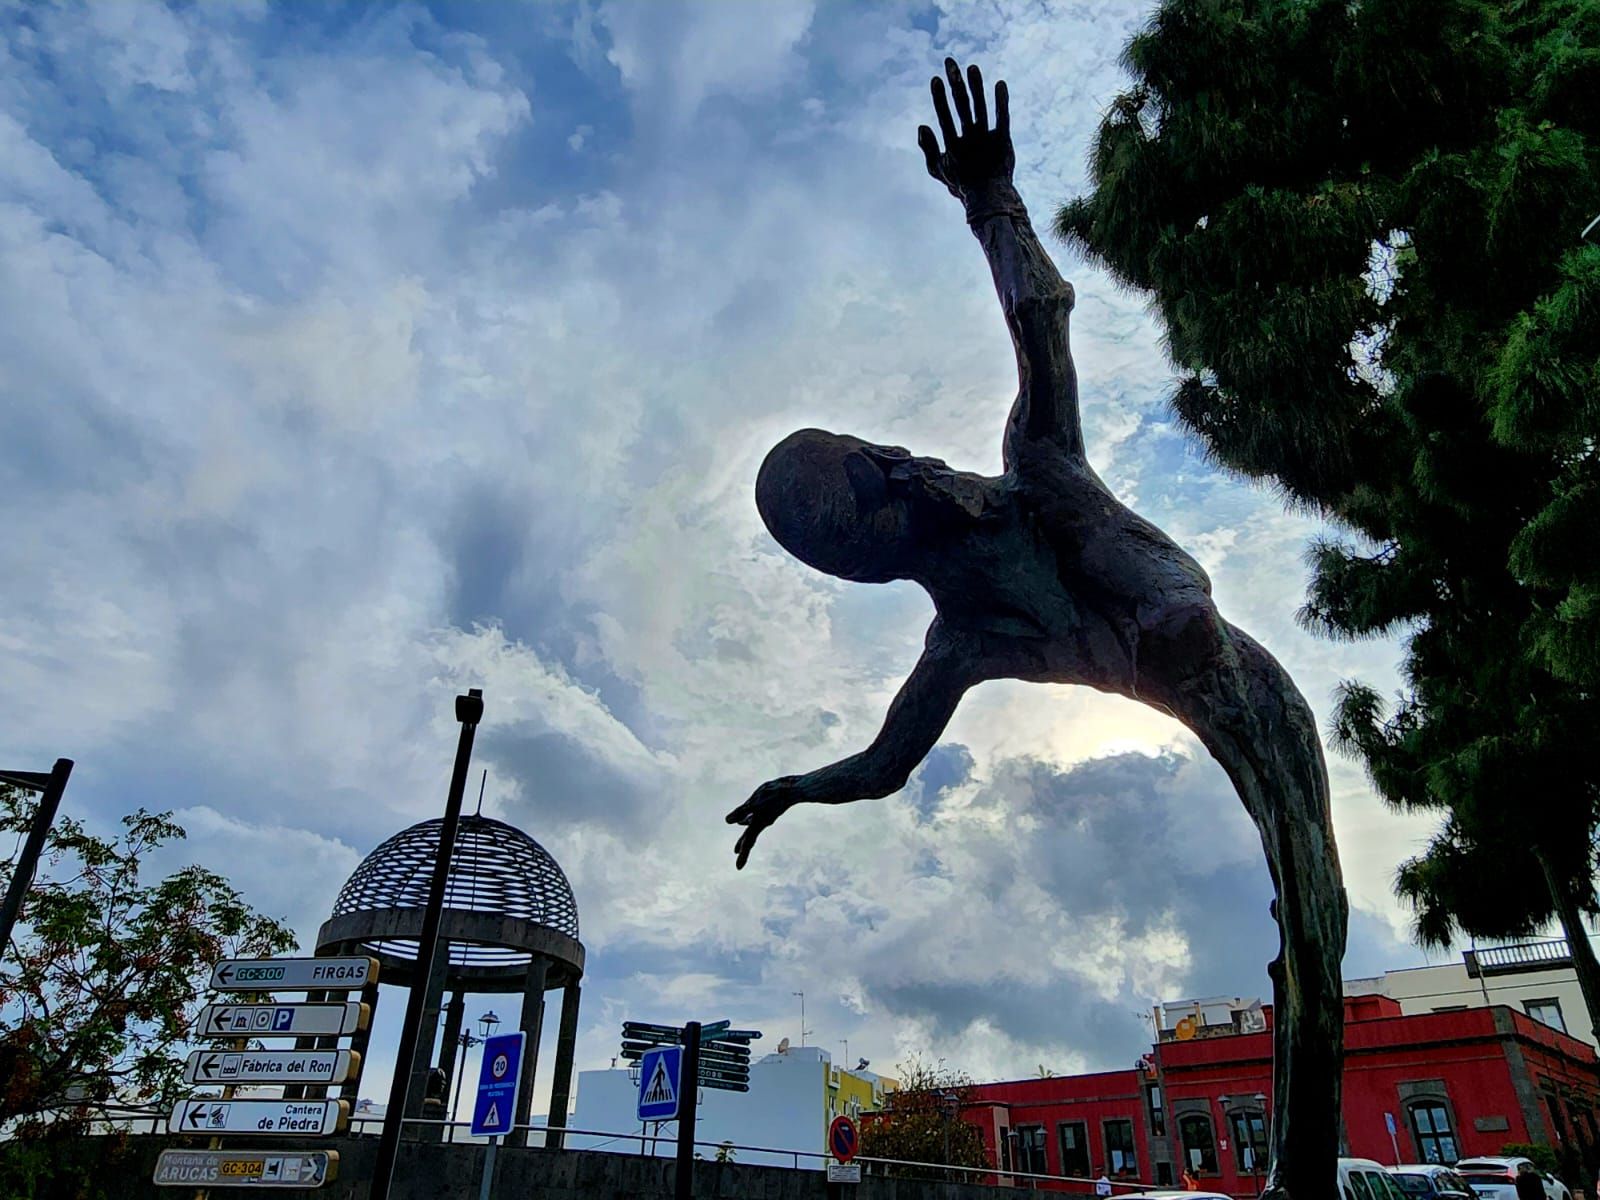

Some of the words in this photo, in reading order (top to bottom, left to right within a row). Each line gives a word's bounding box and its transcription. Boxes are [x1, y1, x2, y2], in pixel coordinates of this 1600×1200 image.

[237, 967, 284, 980] GC-300
[312, 965, 365, 980] FIRGAS
[241, 1058, 282, 1073] Fábrica
[286, 1060, 305, 1073] del
[309, 1060, 332, 1073] Ron
[495, 1061, 506, 1071] 20
[285, 1105, 322, 1115] Cantera
[257, 1117, 275, 1130] de
[278, 1117, 319, 1131] Piedra
[159, 1167, 219, 1181] ARUCAS
[222, 1161, 262, 1174] GC-304
